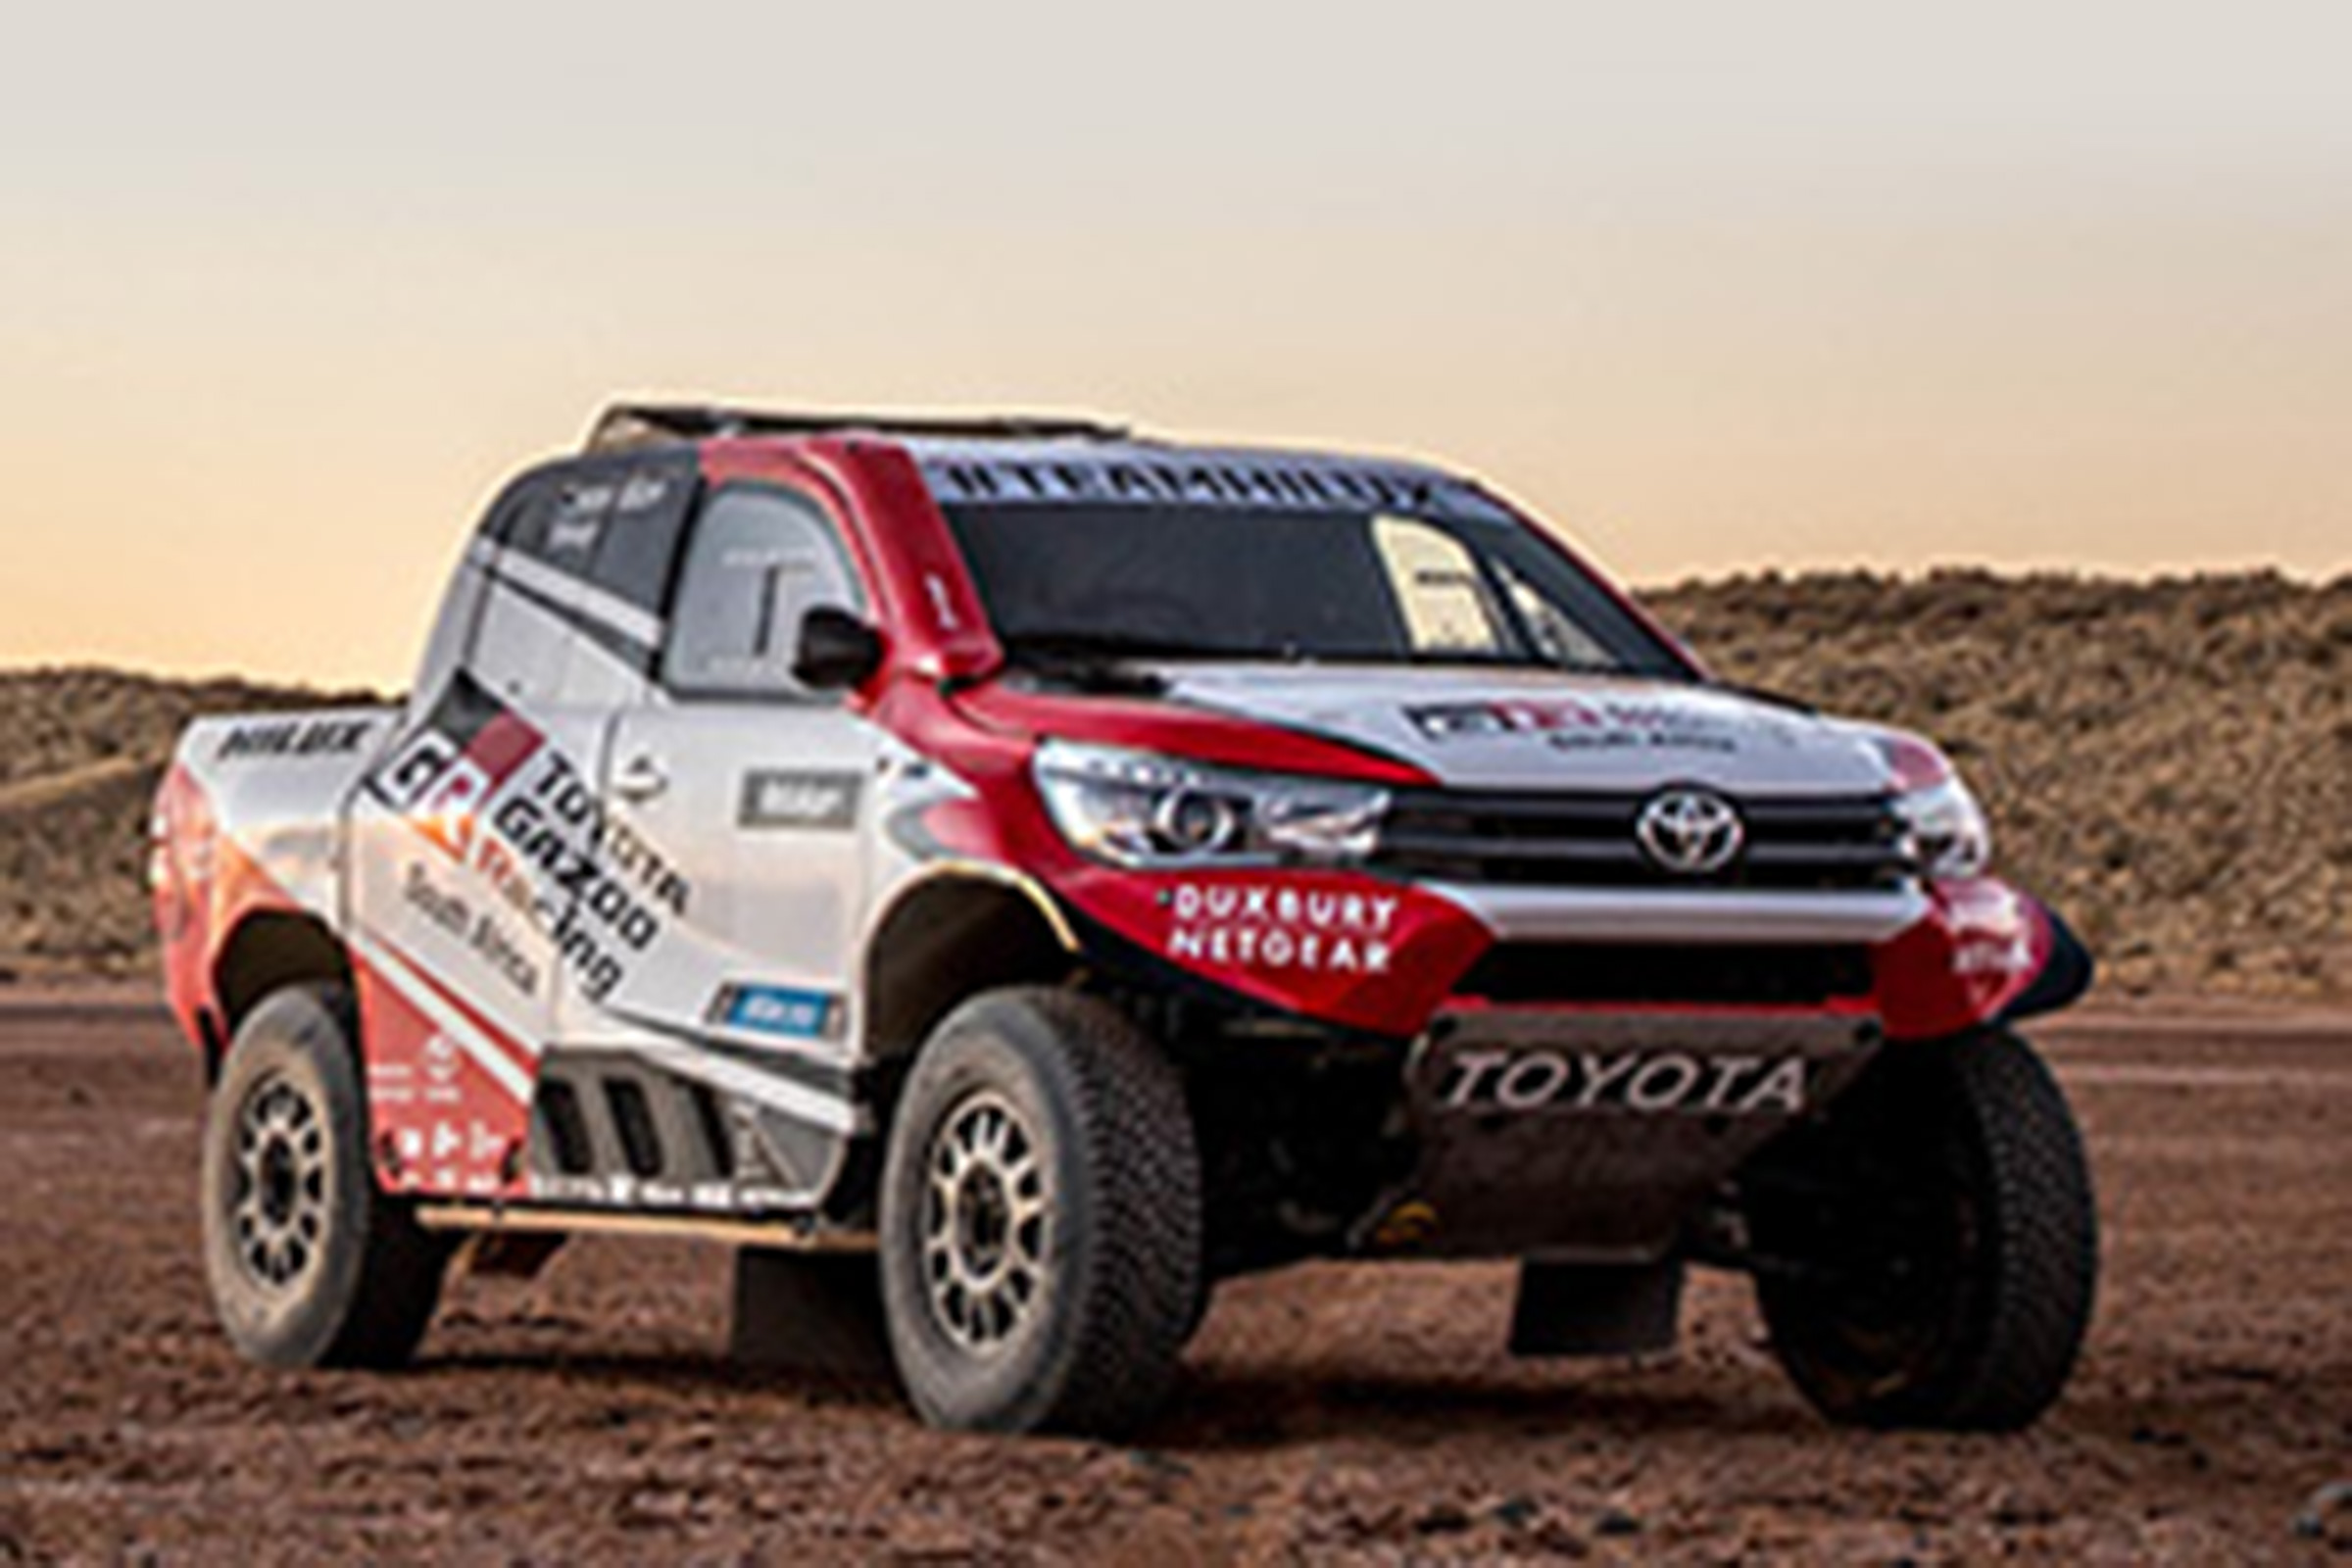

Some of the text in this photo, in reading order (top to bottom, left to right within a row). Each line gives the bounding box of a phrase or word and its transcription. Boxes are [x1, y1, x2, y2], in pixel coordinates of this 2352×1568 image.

[535, 751, 689, 917] TOYOTA
[492, 794, 659, 953] GAZOO
[1174, 882, 1399, 933] DUXBURY
[1166, 927, 1392, 976] NETGEAR
[1445, 1050, 1807, 1113] TOYOTA
